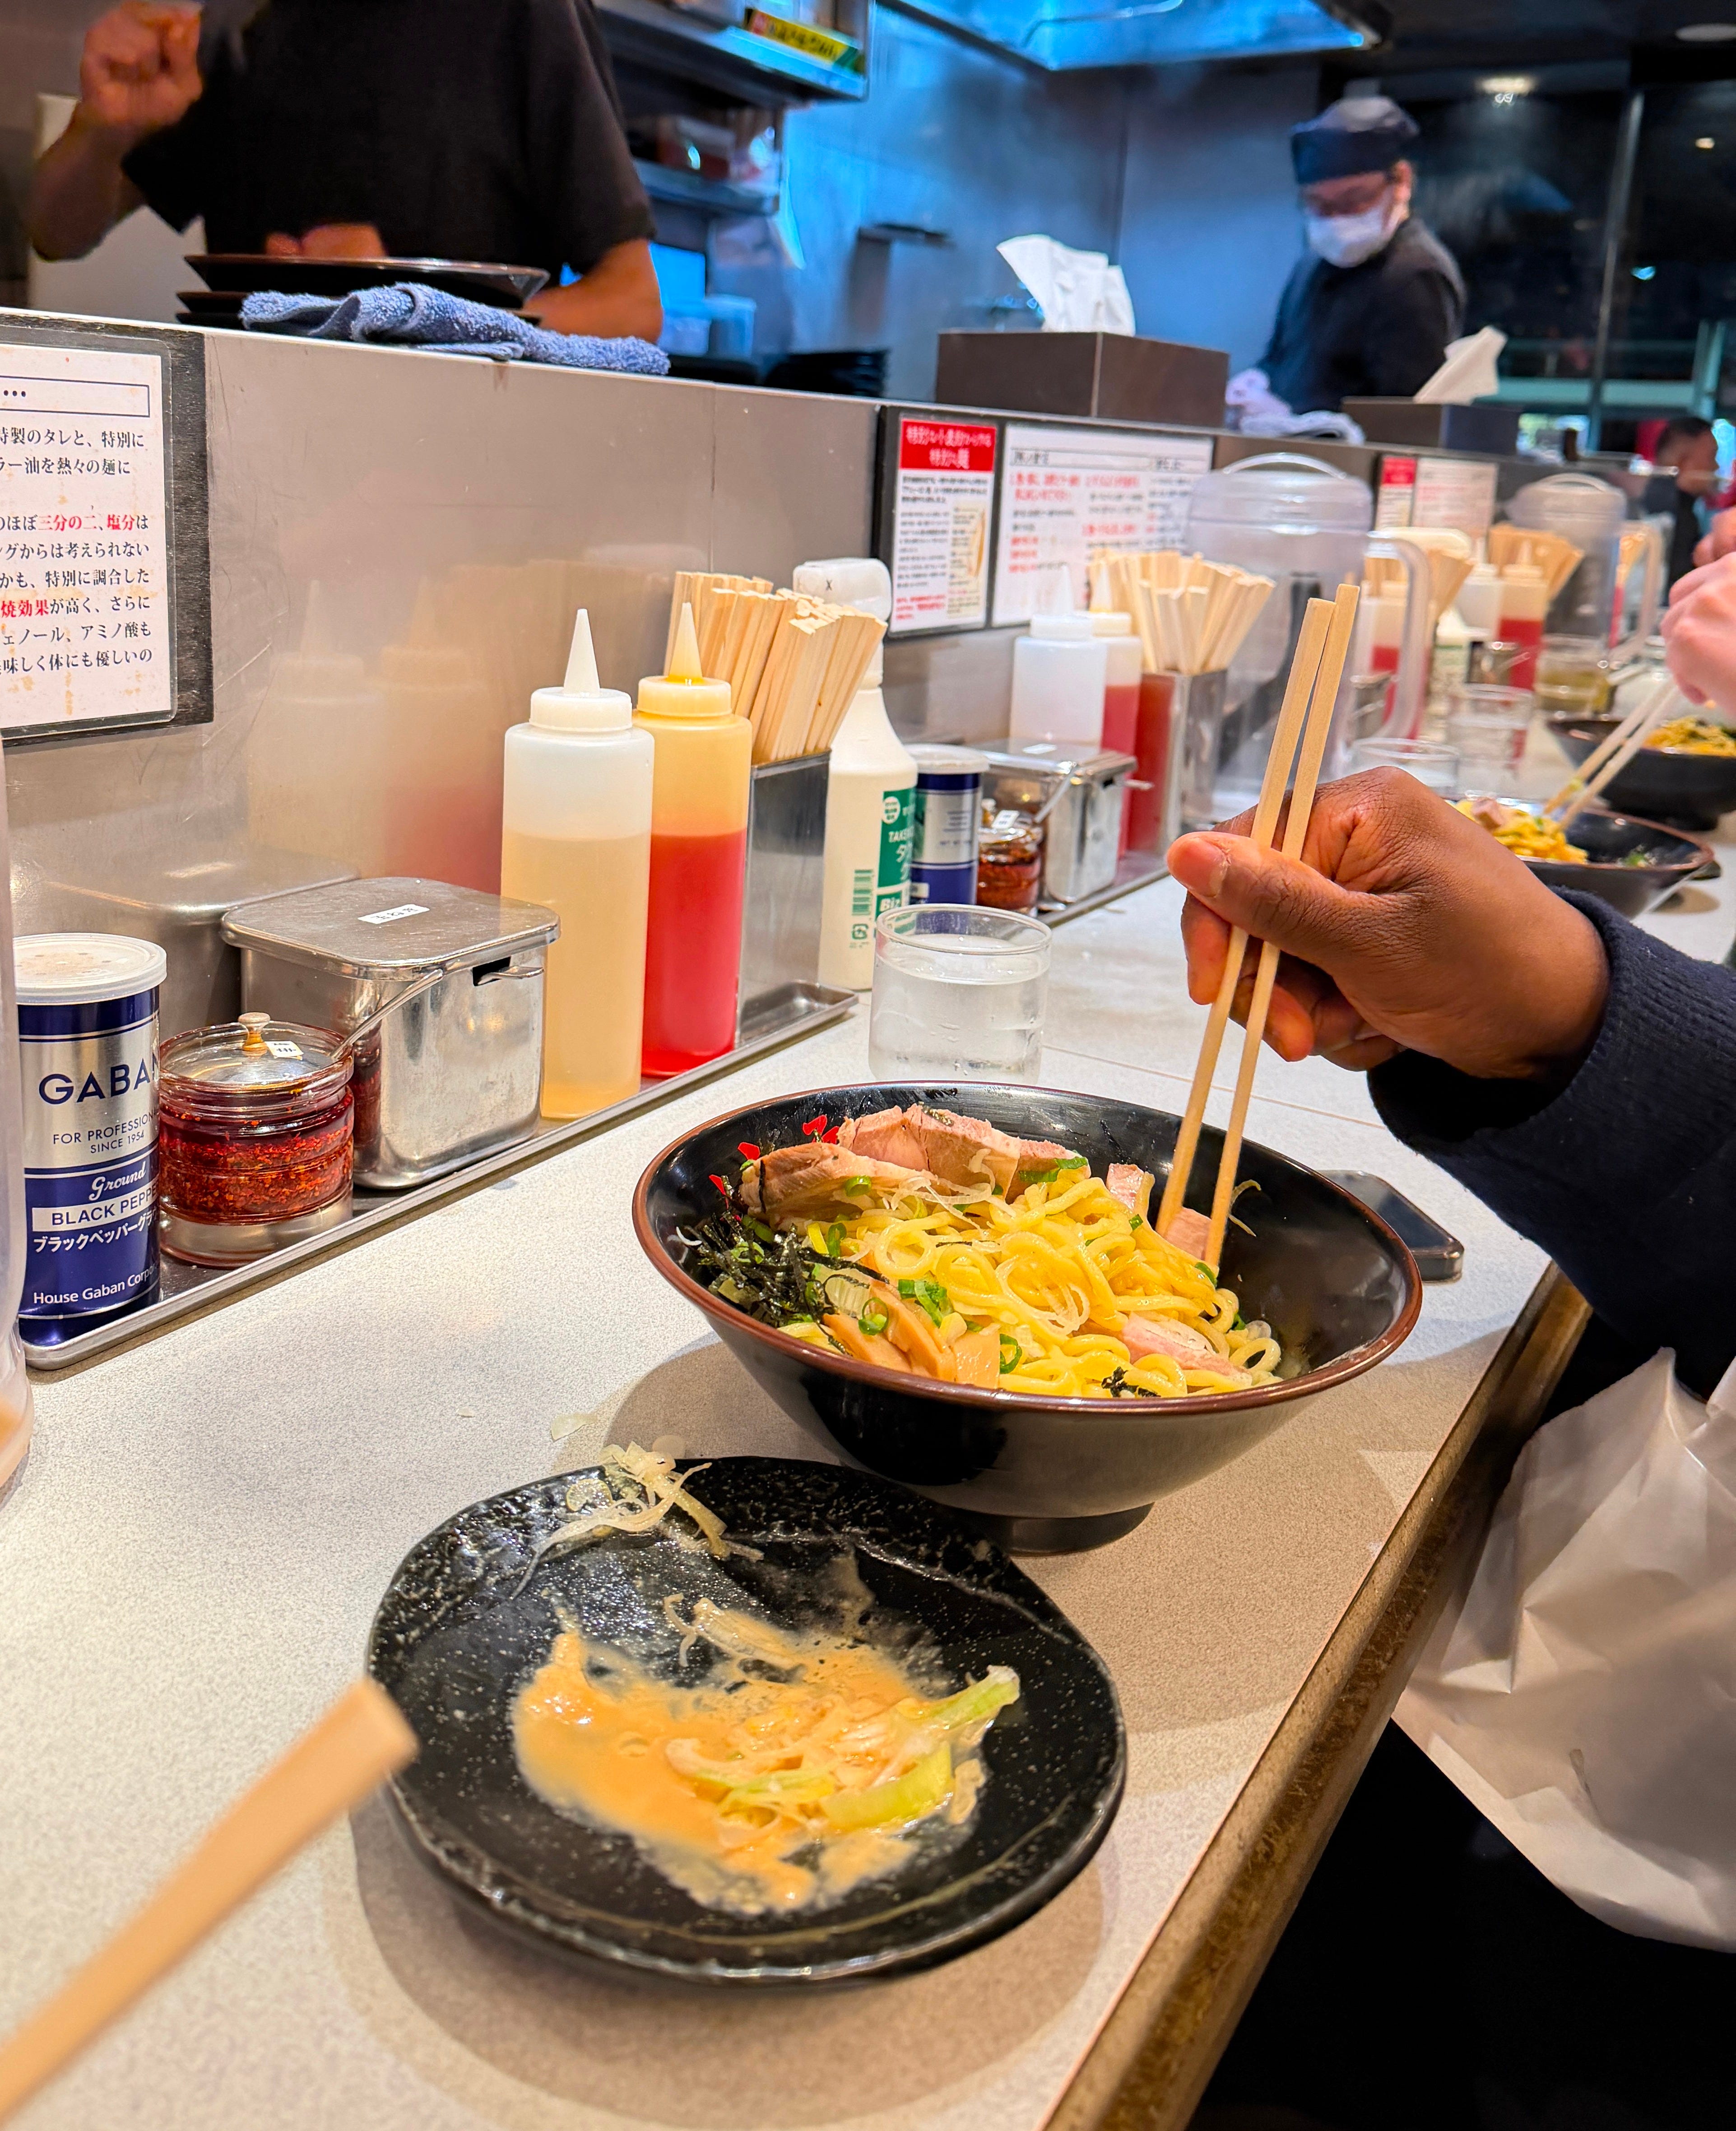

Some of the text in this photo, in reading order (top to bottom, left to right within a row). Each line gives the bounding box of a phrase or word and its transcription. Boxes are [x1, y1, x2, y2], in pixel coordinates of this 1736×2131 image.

[0, 542, 149, 560] グからは考えられない
[0, 649, 152, 674] 味しく体にも優しいの
[53, 1107, 156, 1145] FOR PROFESSION
[91, 1130, 144, 1154] SINCE 1954
[89, 1161, 146, 1201] Ground
[52, 1178, 159, 1226] BLACK PEPPE
[34, 1292, 79, 1304] House
[83, 1281, 125, 1299] Gaban
